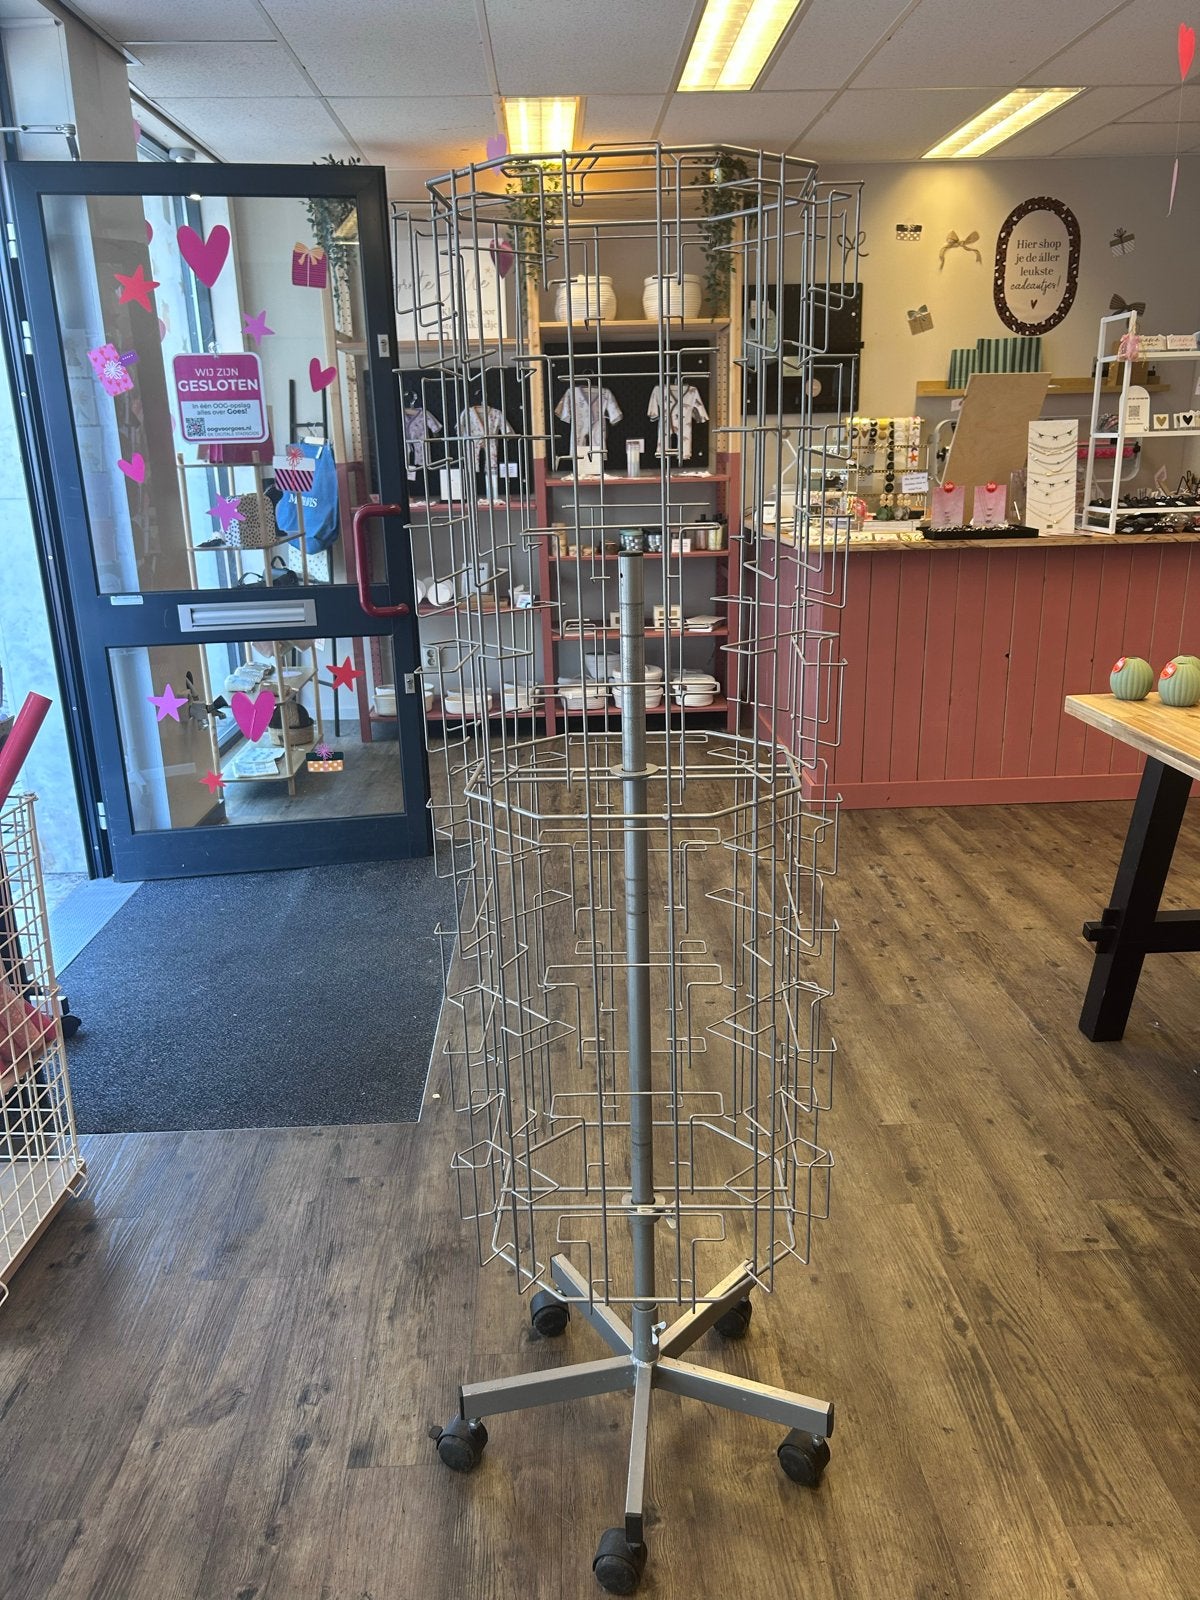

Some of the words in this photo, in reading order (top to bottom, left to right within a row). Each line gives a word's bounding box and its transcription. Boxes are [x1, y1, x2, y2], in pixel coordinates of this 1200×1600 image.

[1017, 240, 1038, 249] Hier
[1039, 239, 1062, 250] shop
[1014, 254, 1024, 265] je
[1025, 253, 1037, 262] de
[1020, 267, 1054, 276] leukste
[1010, 275, 1062, 295] cadeautjes!
[194, 368, 214, 377] WIJ
[216, 367, 239, 377] ZIJN
[177, 379, 259, 392] GESLOTEN
[206, 425, 252, 433] oogvoorgoes.nl
